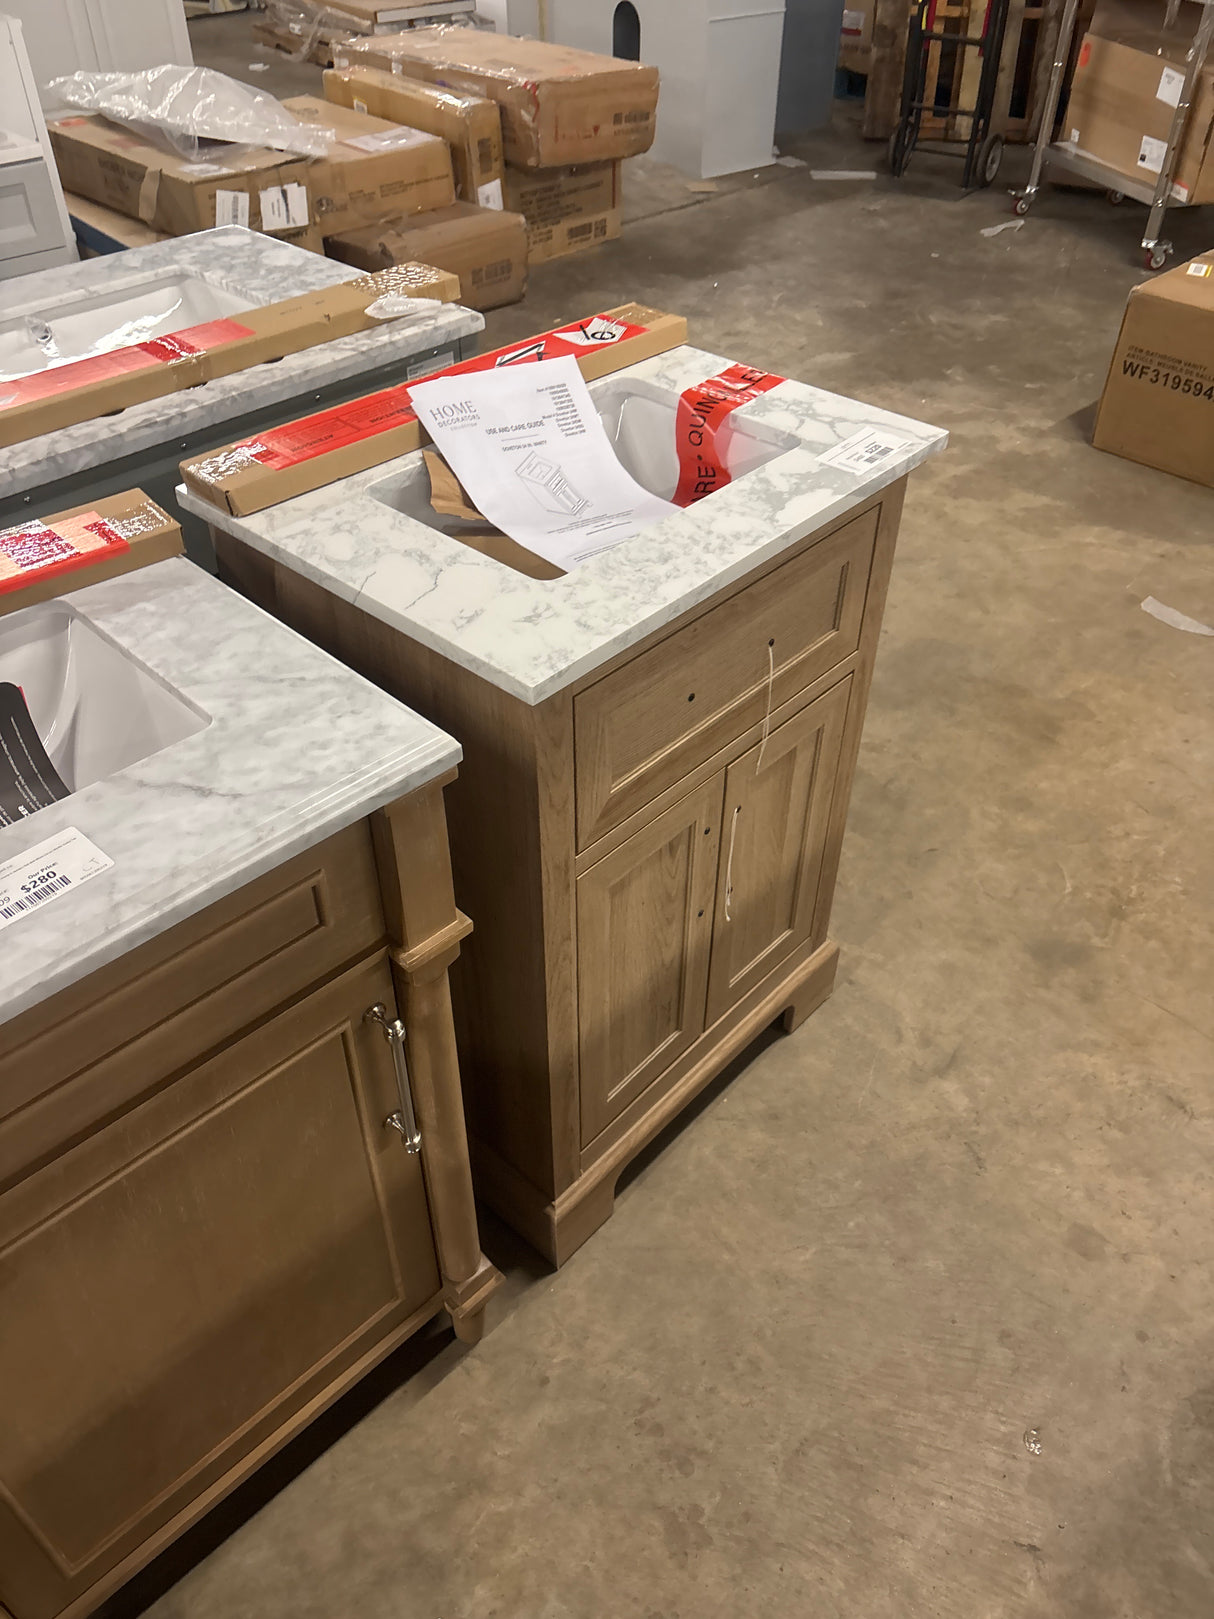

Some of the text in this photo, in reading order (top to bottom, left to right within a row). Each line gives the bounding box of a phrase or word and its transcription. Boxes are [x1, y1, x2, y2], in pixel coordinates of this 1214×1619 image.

[429, 400, 477, 421] HOME
[437, 414, 480, 428] DECORATORS
[20, 870, 57, 893] $280
[27, 871, 39, 880] Our
